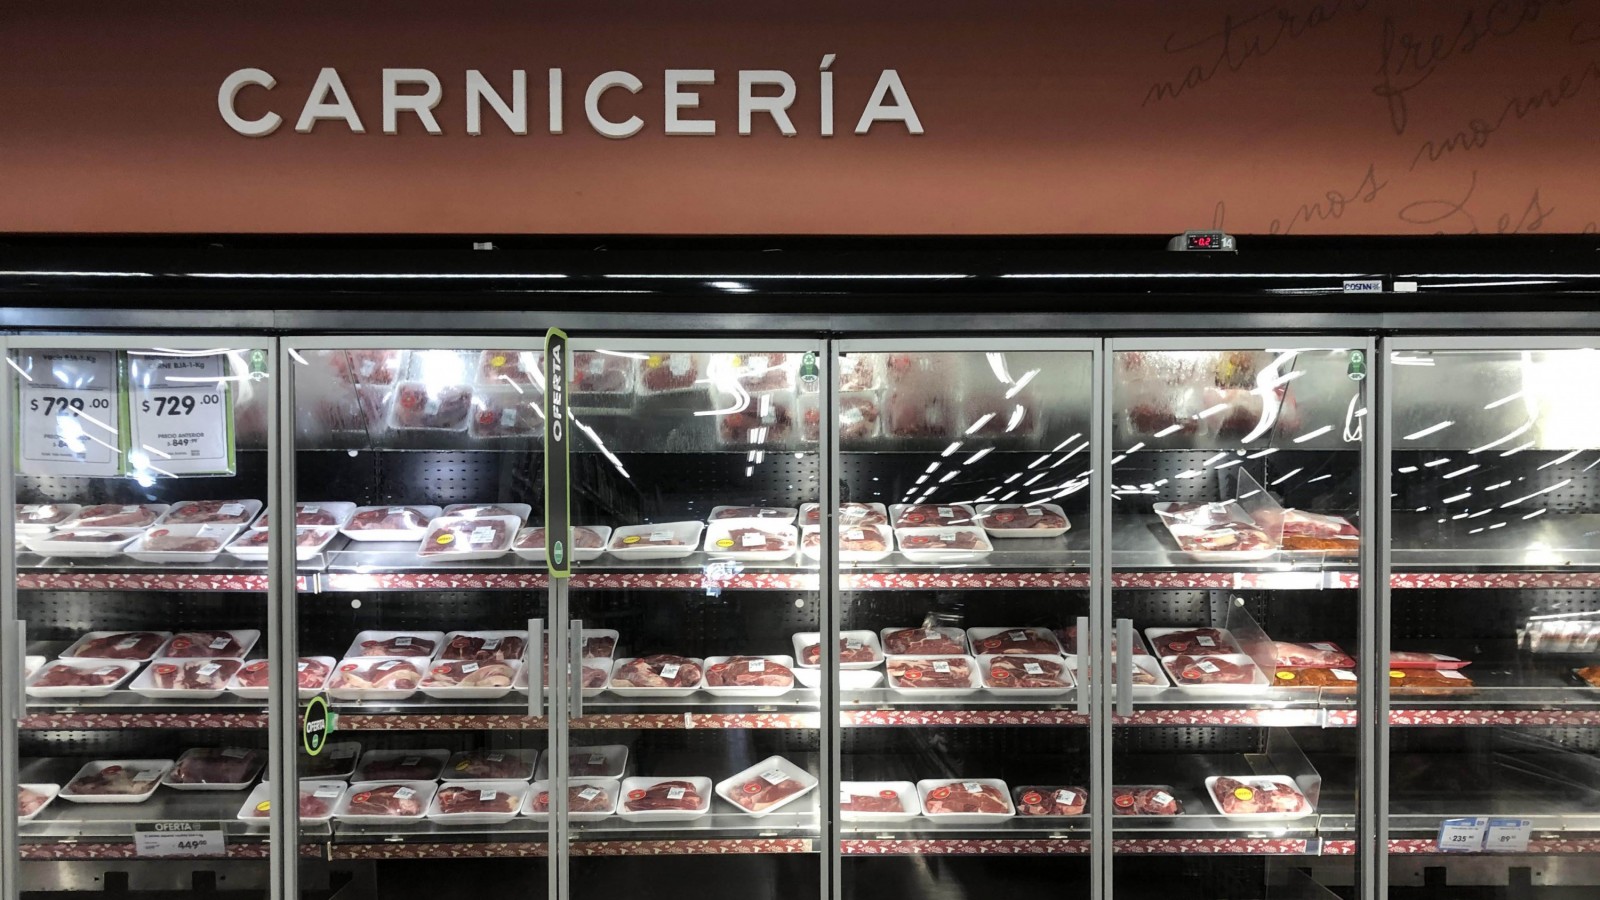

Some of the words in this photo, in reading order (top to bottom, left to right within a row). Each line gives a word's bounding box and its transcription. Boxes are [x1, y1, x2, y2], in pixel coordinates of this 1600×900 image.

[1142, 0, 1367, 107] natura
[217, 54, 924, 137] CARNICERÍA
[1221, 238, 1233, 248] 14
[553, 344, 562, 442] OFERTA
[155, 823, 192, 831] OFERTA
